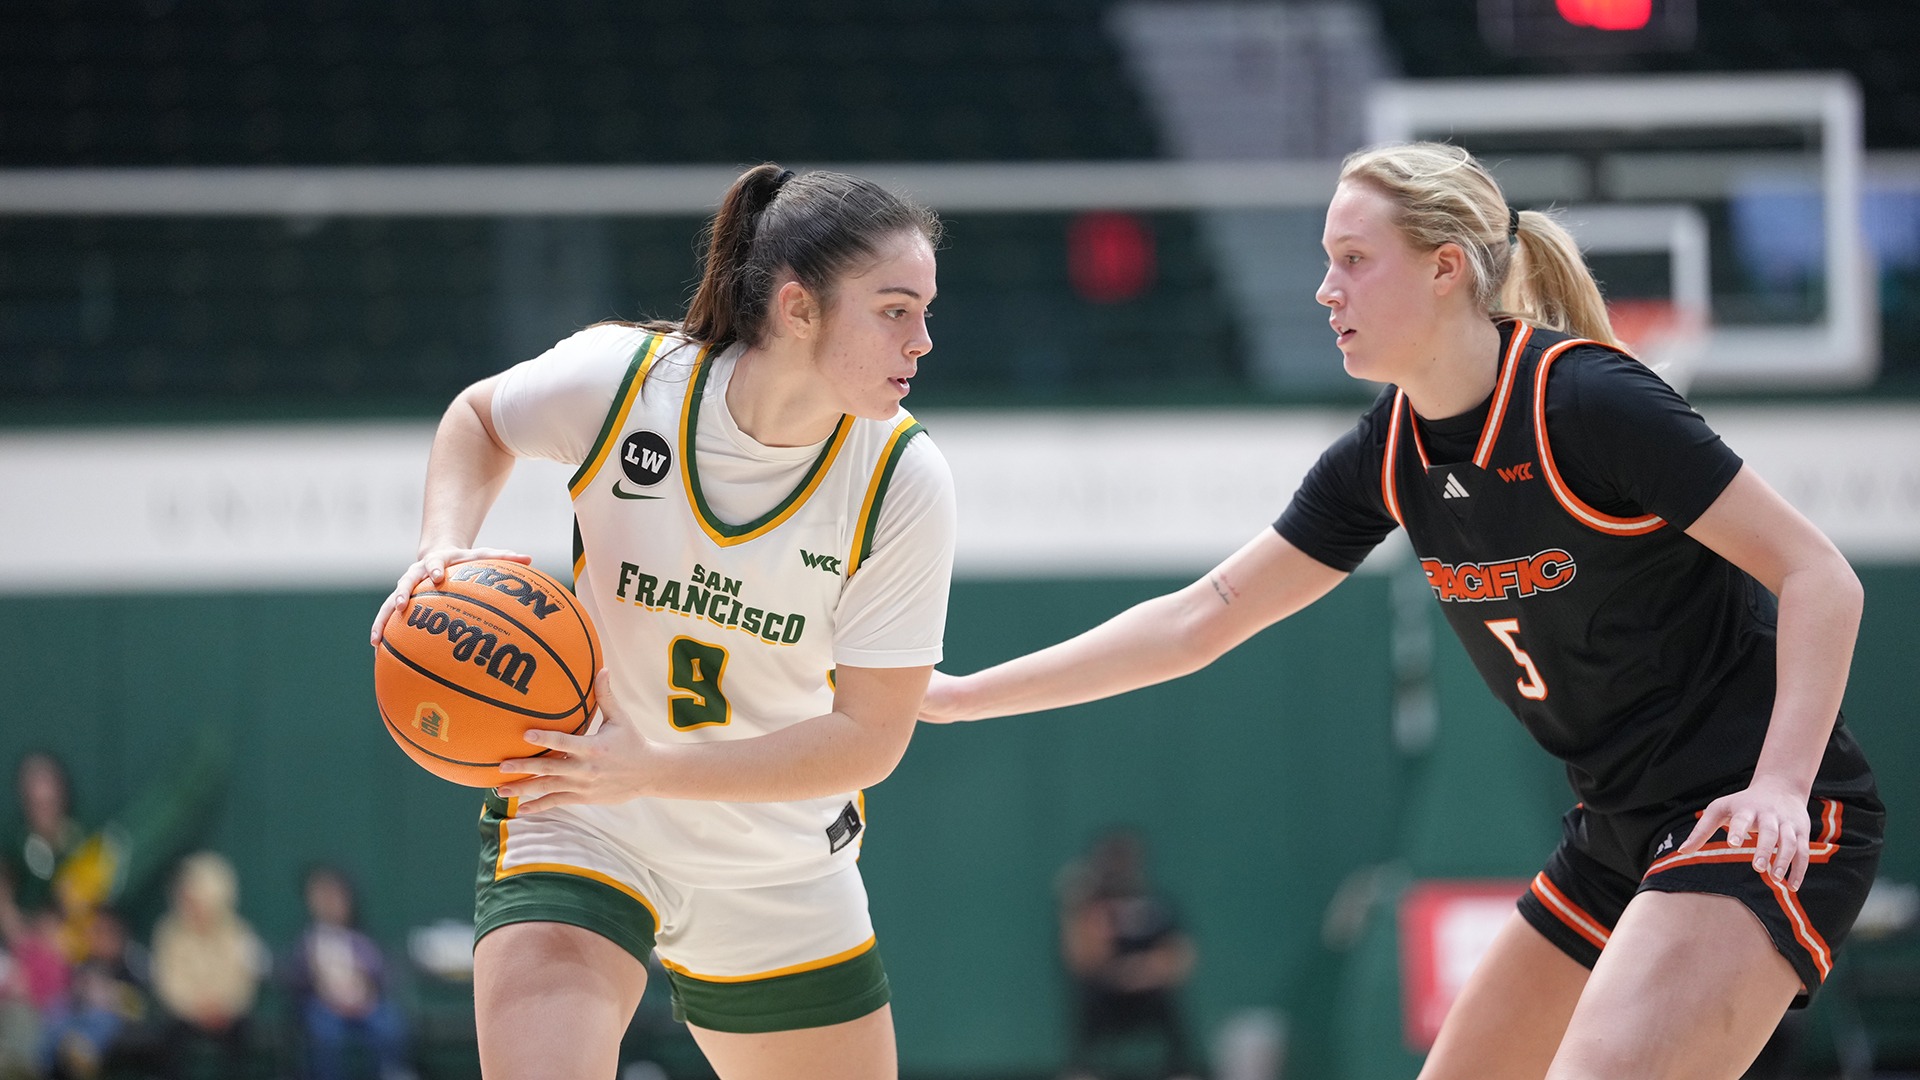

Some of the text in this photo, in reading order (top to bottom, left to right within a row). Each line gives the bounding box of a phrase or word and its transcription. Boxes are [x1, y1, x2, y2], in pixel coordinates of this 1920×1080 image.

[624, 442, 667, 475] LW
[1496, 461, 1534, 483] WCC
[691, 563, 743, 598] SAN
[799, 549, 842, 576] WCC
[1420, 548, 1577, 602] PACIFIC
[449, 565, 562, 621] NCAA
[616, 561, 806, 647] FRANCISCO
[407, 603, 537, 695] Wilson
[1484, 618, 1548, 701] 5
[667, 634, 732, 732] 9
